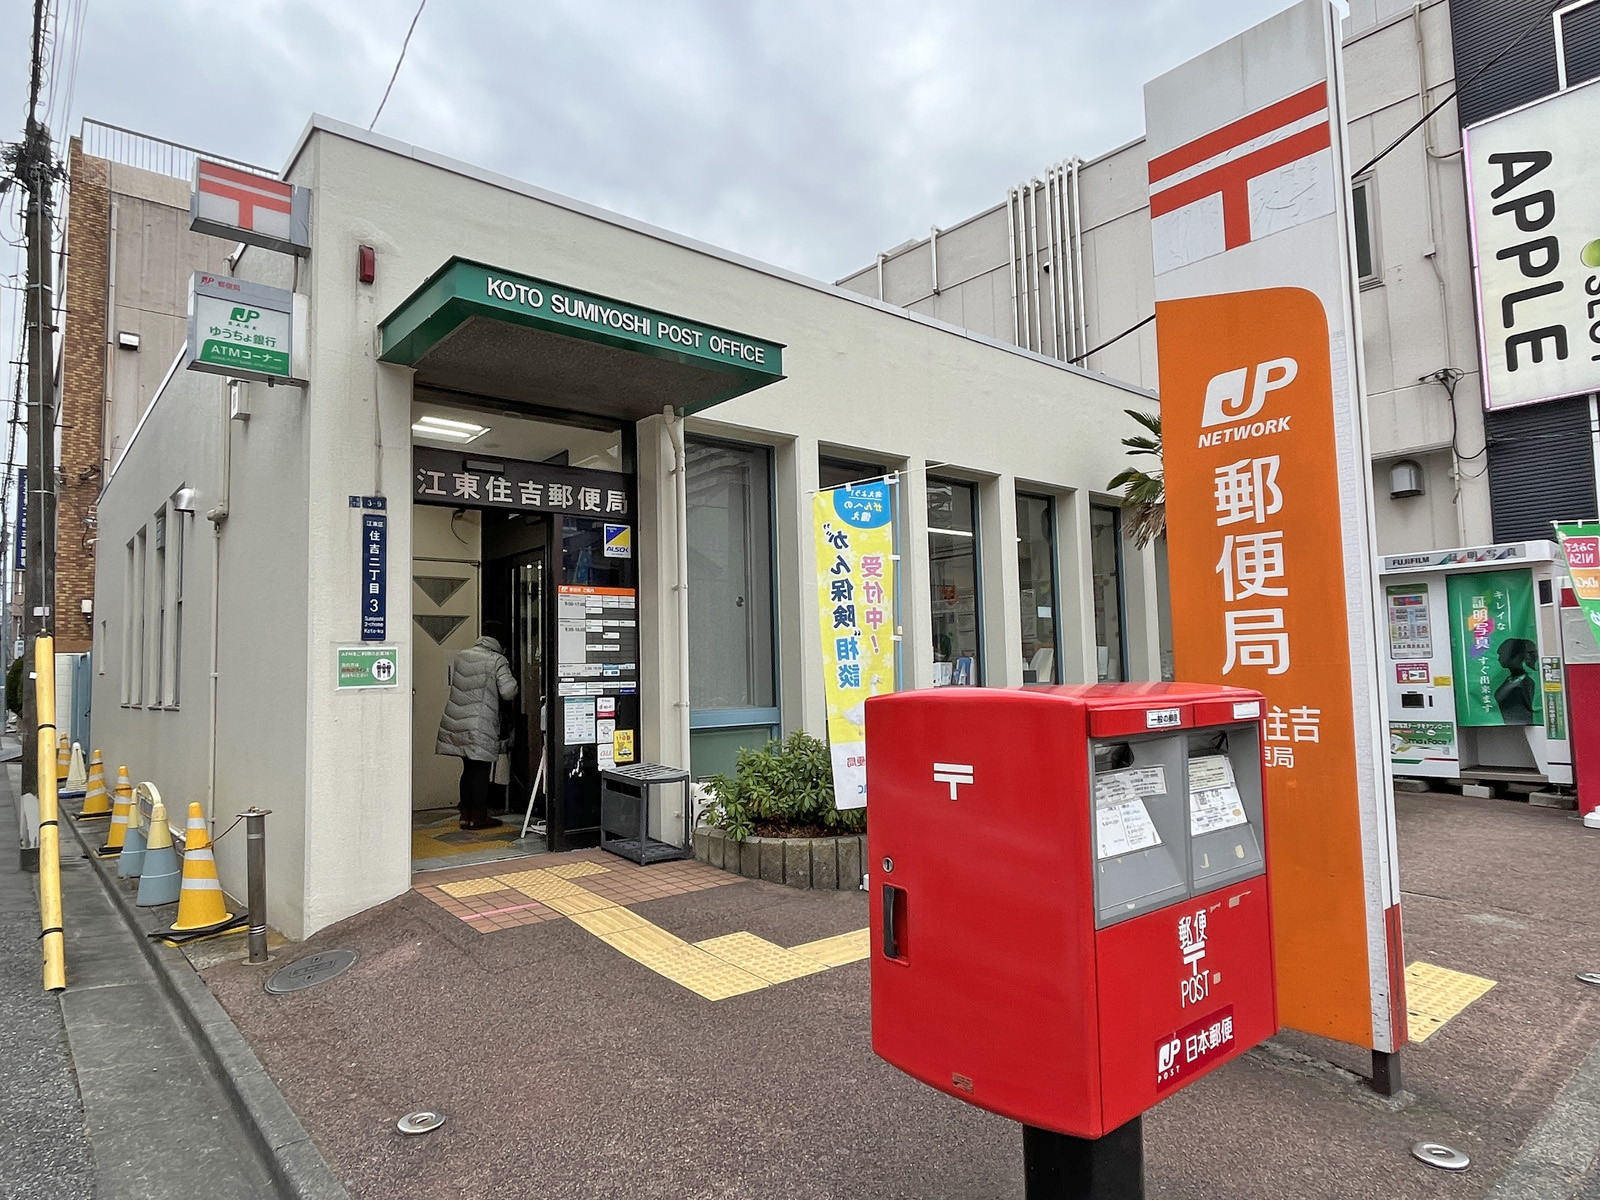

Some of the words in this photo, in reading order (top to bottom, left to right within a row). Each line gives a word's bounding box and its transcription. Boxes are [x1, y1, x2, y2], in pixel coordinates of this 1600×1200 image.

[1488, 150, 1568, 372] APPLE
[228, 322, 257, 330] BANK
[230, 307, 260, 323] JP
[487, 277, 544, 308] KOTO
[551, 294, 651, 336] SUMIYOSHI
[658, 322, 702, 349] POST
[710, 335, 765, 364] OFFICE
[210, 326, 277, 347] ゆうちょ銀行
[211, 345, 282, 362] ATMコーナー
[1201, 357, 1298, 428] JP
[1198, 416, 1292, 448] NETWORK
[416, 468, 628, 514] 江東住吉郵便局
[369, 530, 381, 594] 住吉二丁目
[1214, 454, 1291, 675] 郵便局
[1392, 556, 1430, 566] FUJIFILM
[1450, 547, 1516, 562] 証明写真
[370, 599, 378, 612] 3
[1472, 596, 1490, 649] 証明写真
[1494, 590, 1507, 630] キレイな
[1478, 656, 1493, 713] すぐ出来ます
[1263, 705, 1321, 743] 住吉
[1178, 909, 1208, 950] 郵便
[1181, 970, 1210, 1008] POST
[1158, 1039, 1181, 1073] JP
[1186, 1016, 1234, 1063] 日本郵便
[1157, 1064, 1180, 1083] POST
